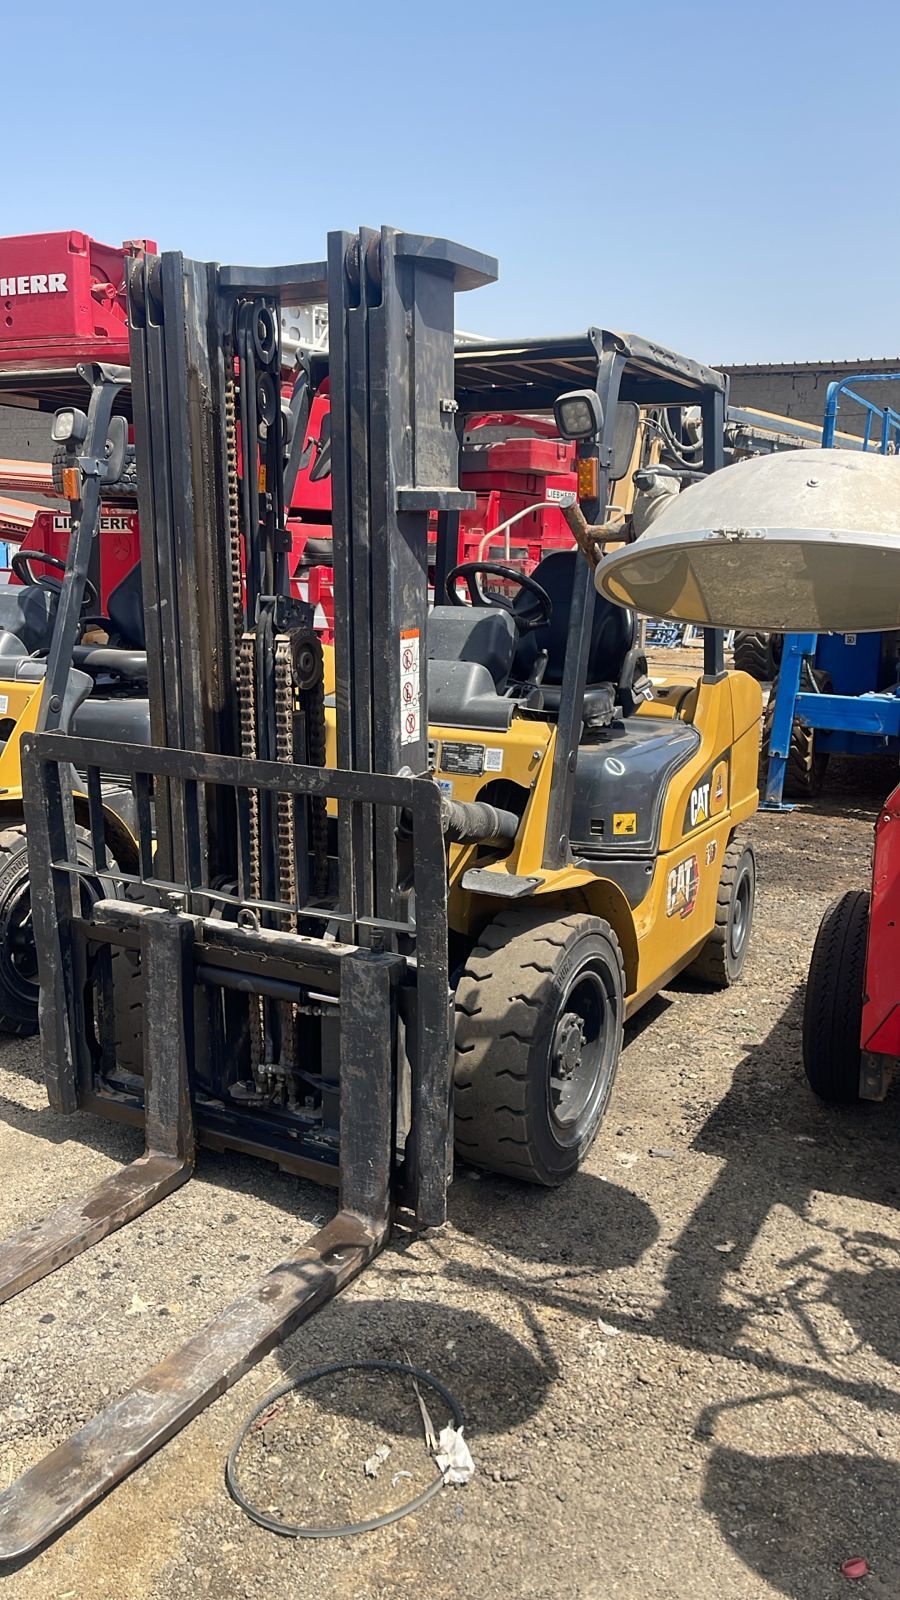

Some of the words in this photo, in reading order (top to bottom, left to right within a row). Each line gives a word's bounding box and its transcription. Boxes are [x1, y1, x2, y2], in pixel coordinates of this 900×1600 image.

[0, 273, 68, 296] HERR
[54, 517, 128, 530] LIERR
[690, 783, 710, 826] CAT
[667, 858, 693, 914] CAT
